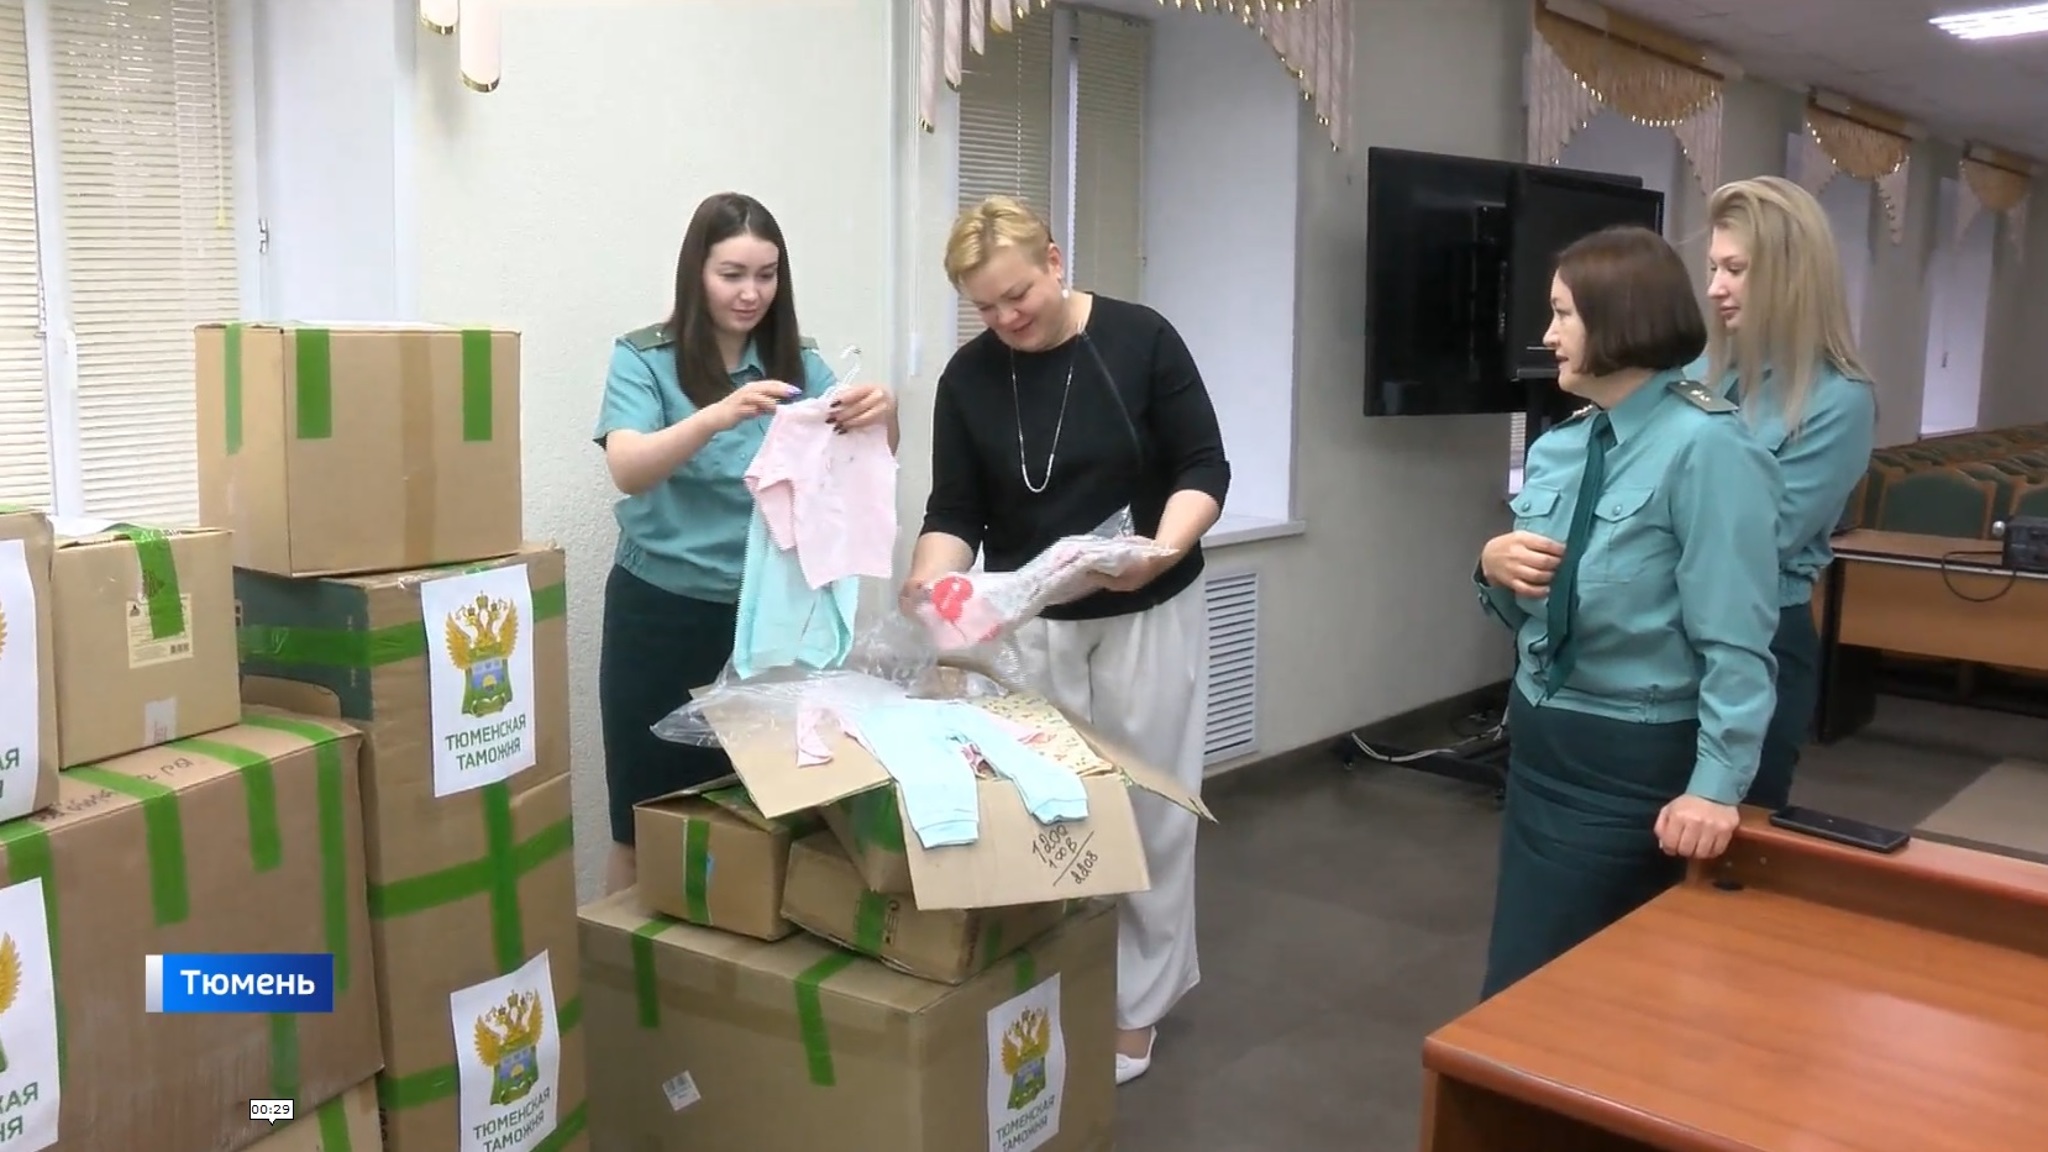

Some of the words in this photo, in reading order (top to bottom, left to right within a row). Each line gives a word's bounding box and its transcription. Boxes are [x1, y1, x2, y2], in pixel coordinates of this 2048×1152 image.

[444, 713, 526, 751] ТЮМЕНСКАЯ
[456, 737, 521, 771] ТАМОЖНЯ
[1032, 824, 1069, 864] 1200
[473, 1086, 550, 1140] ТЮМЕНСКАЯ
[483, 1109, 544, 1152] ТАМОЖНЯ
